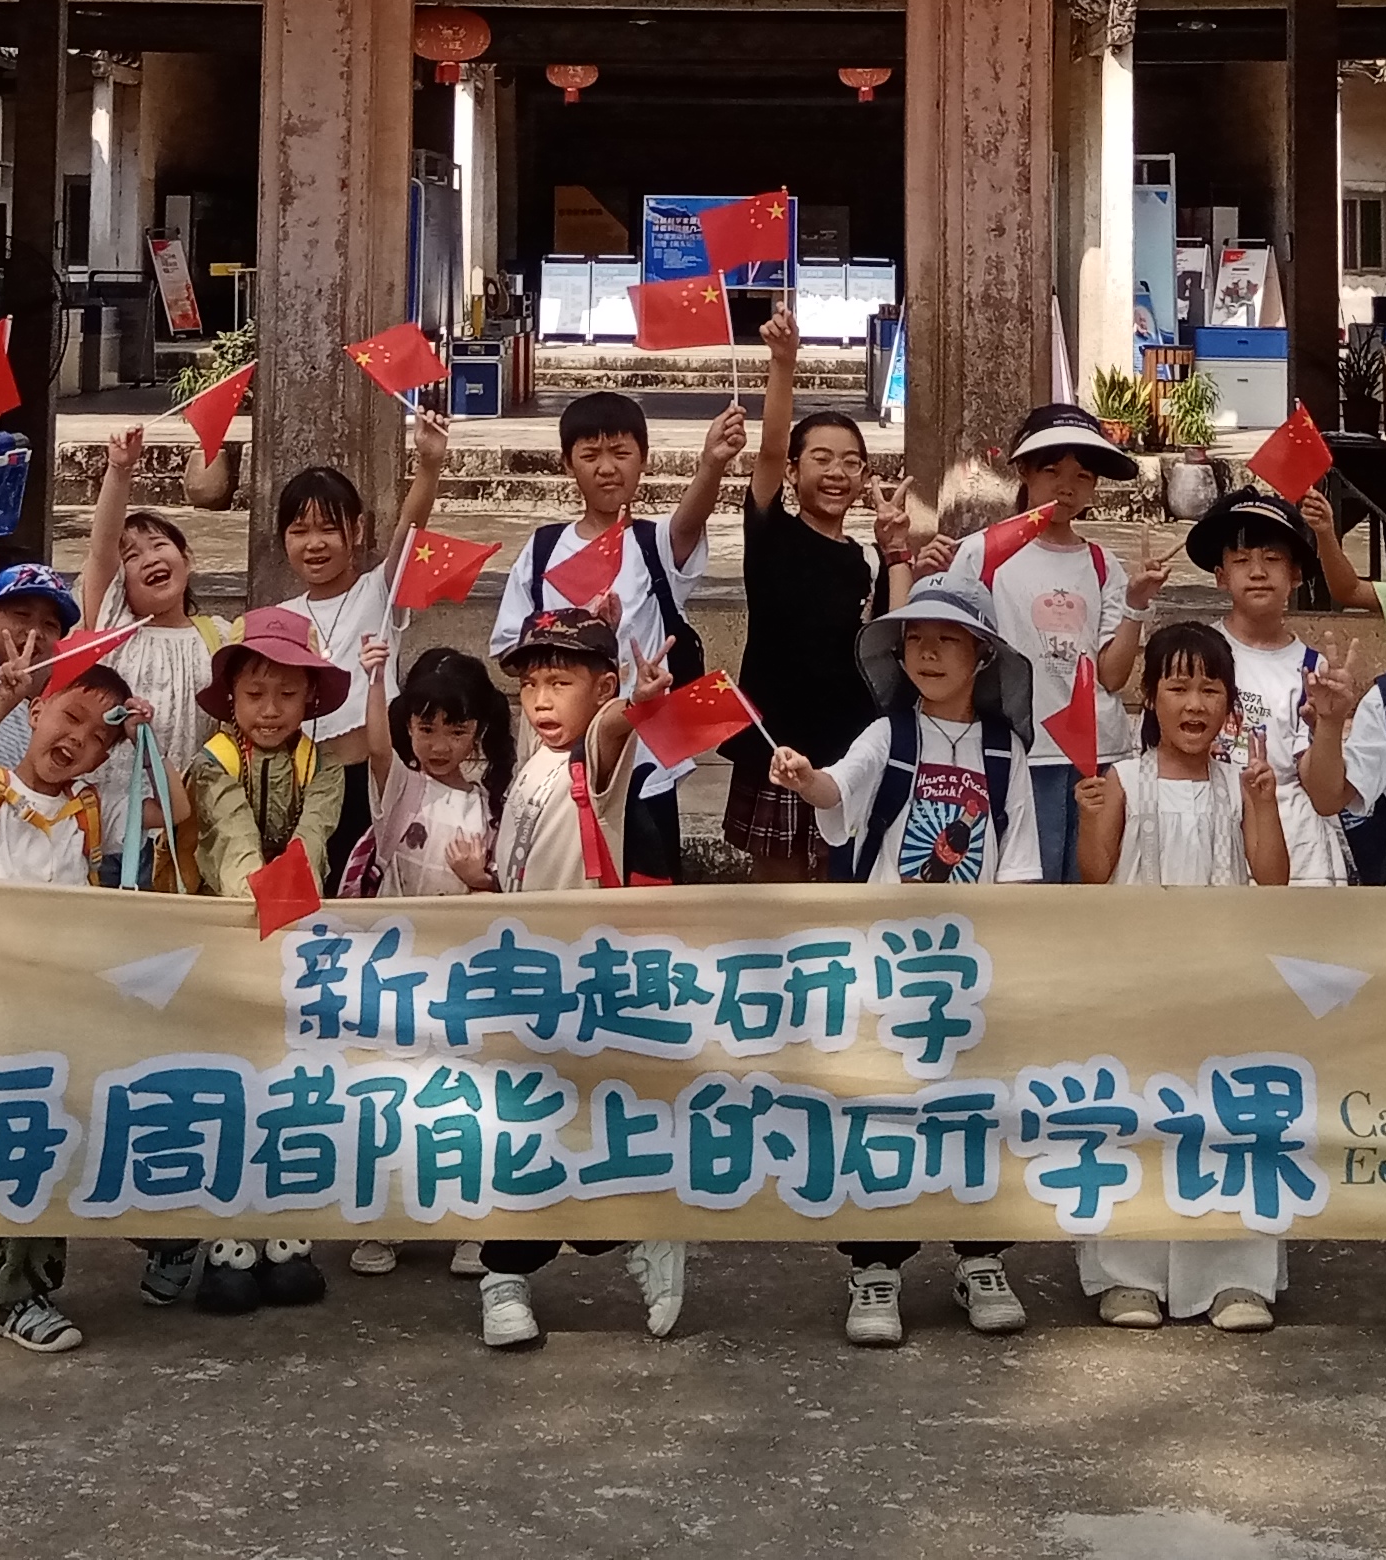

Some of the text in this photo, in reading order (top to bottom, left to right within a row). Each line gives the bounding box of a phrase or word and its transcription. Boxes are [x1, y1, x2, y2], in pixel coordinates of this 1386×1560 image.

[917, 772, 989, 800] Have a Grea
[922, 784, 964, 799] Drink!
